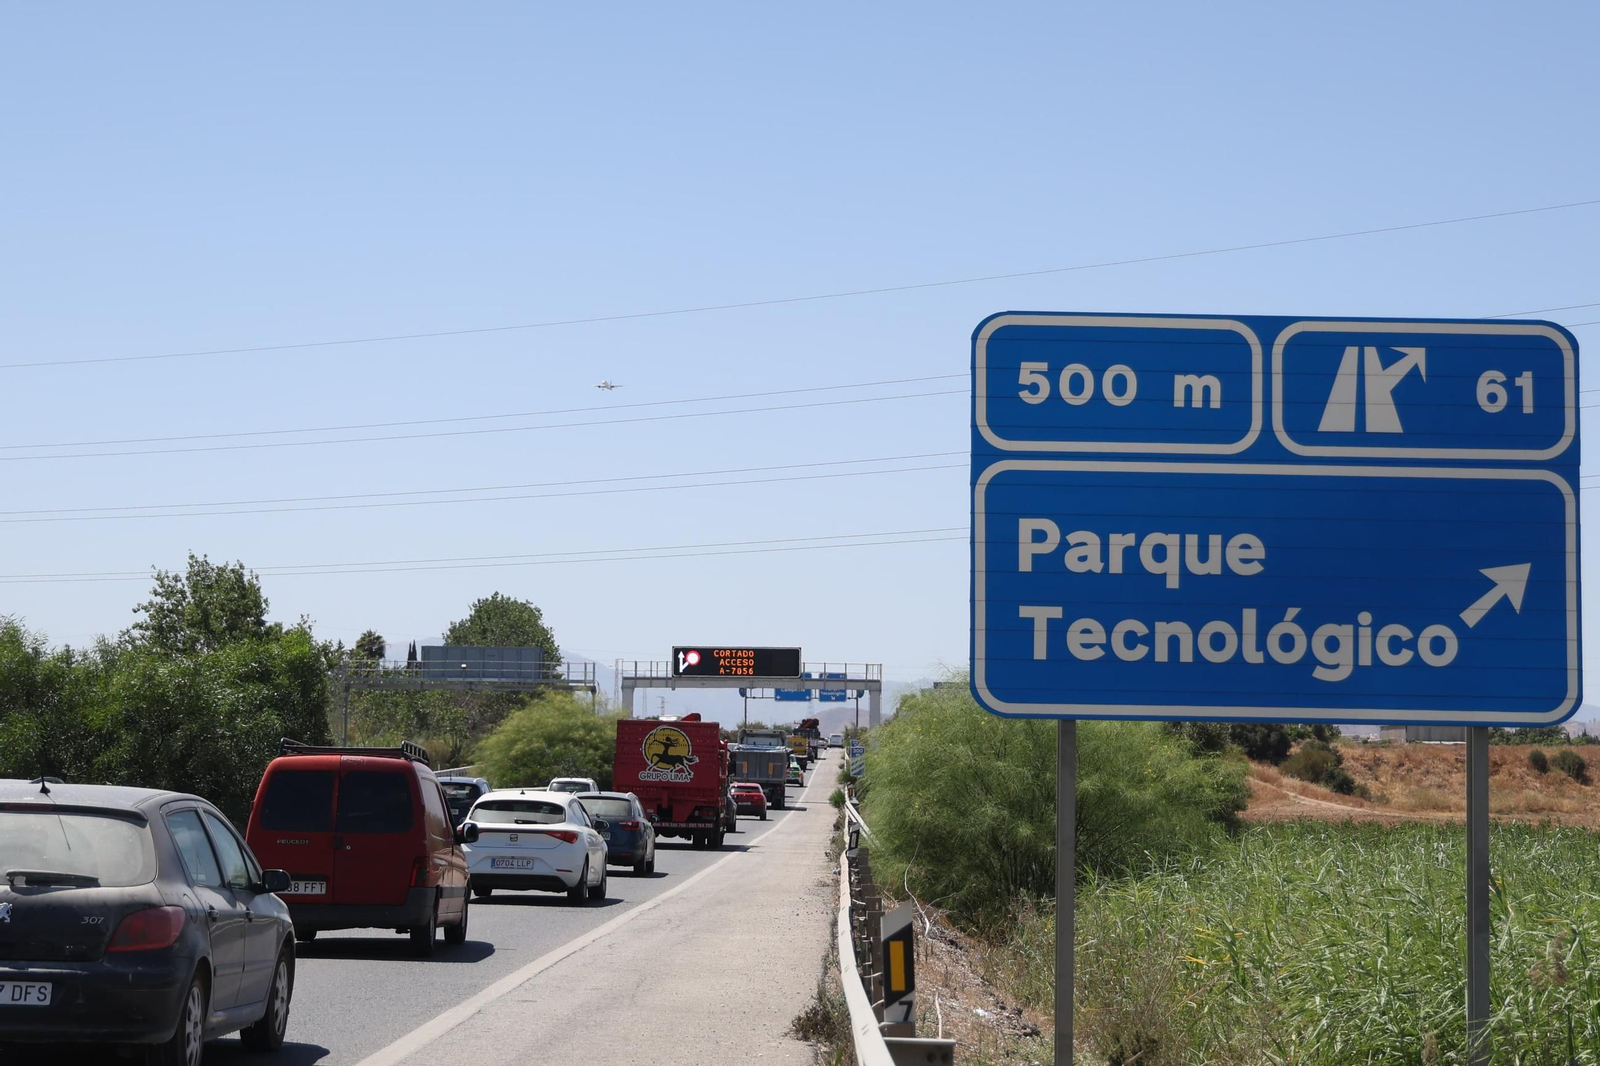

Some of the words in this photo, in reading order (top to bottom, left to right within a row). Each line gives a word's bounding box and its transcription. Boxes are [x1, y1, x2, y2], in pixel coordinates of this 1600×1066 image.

[1018, 361, 1138, 407] 500
[1173, 374, 1222, 409] m
[1476, 370, 1534, 414] 61
[1018, 518, 1266, 589] Parque
[1018, 605, 1458, 682] Tecnológico
[713, 649, 755, 658] CORTADO
[719, 658, 755, 666] ACCESO
[719, 667, 754, 675] A-7056
[639, 771, 669, 781] GRUPO
[670, 772, 690, 782] LIMA
[276, 838, 310, 846] PEUGEOT
[495, 859, 515, 867] 0704
[516, 860, 532, 868] LLP
[304, 882, 325, 893] FFT
[81, 916, 105, 925] 307
[11, 984, 48, 1002] DFS
